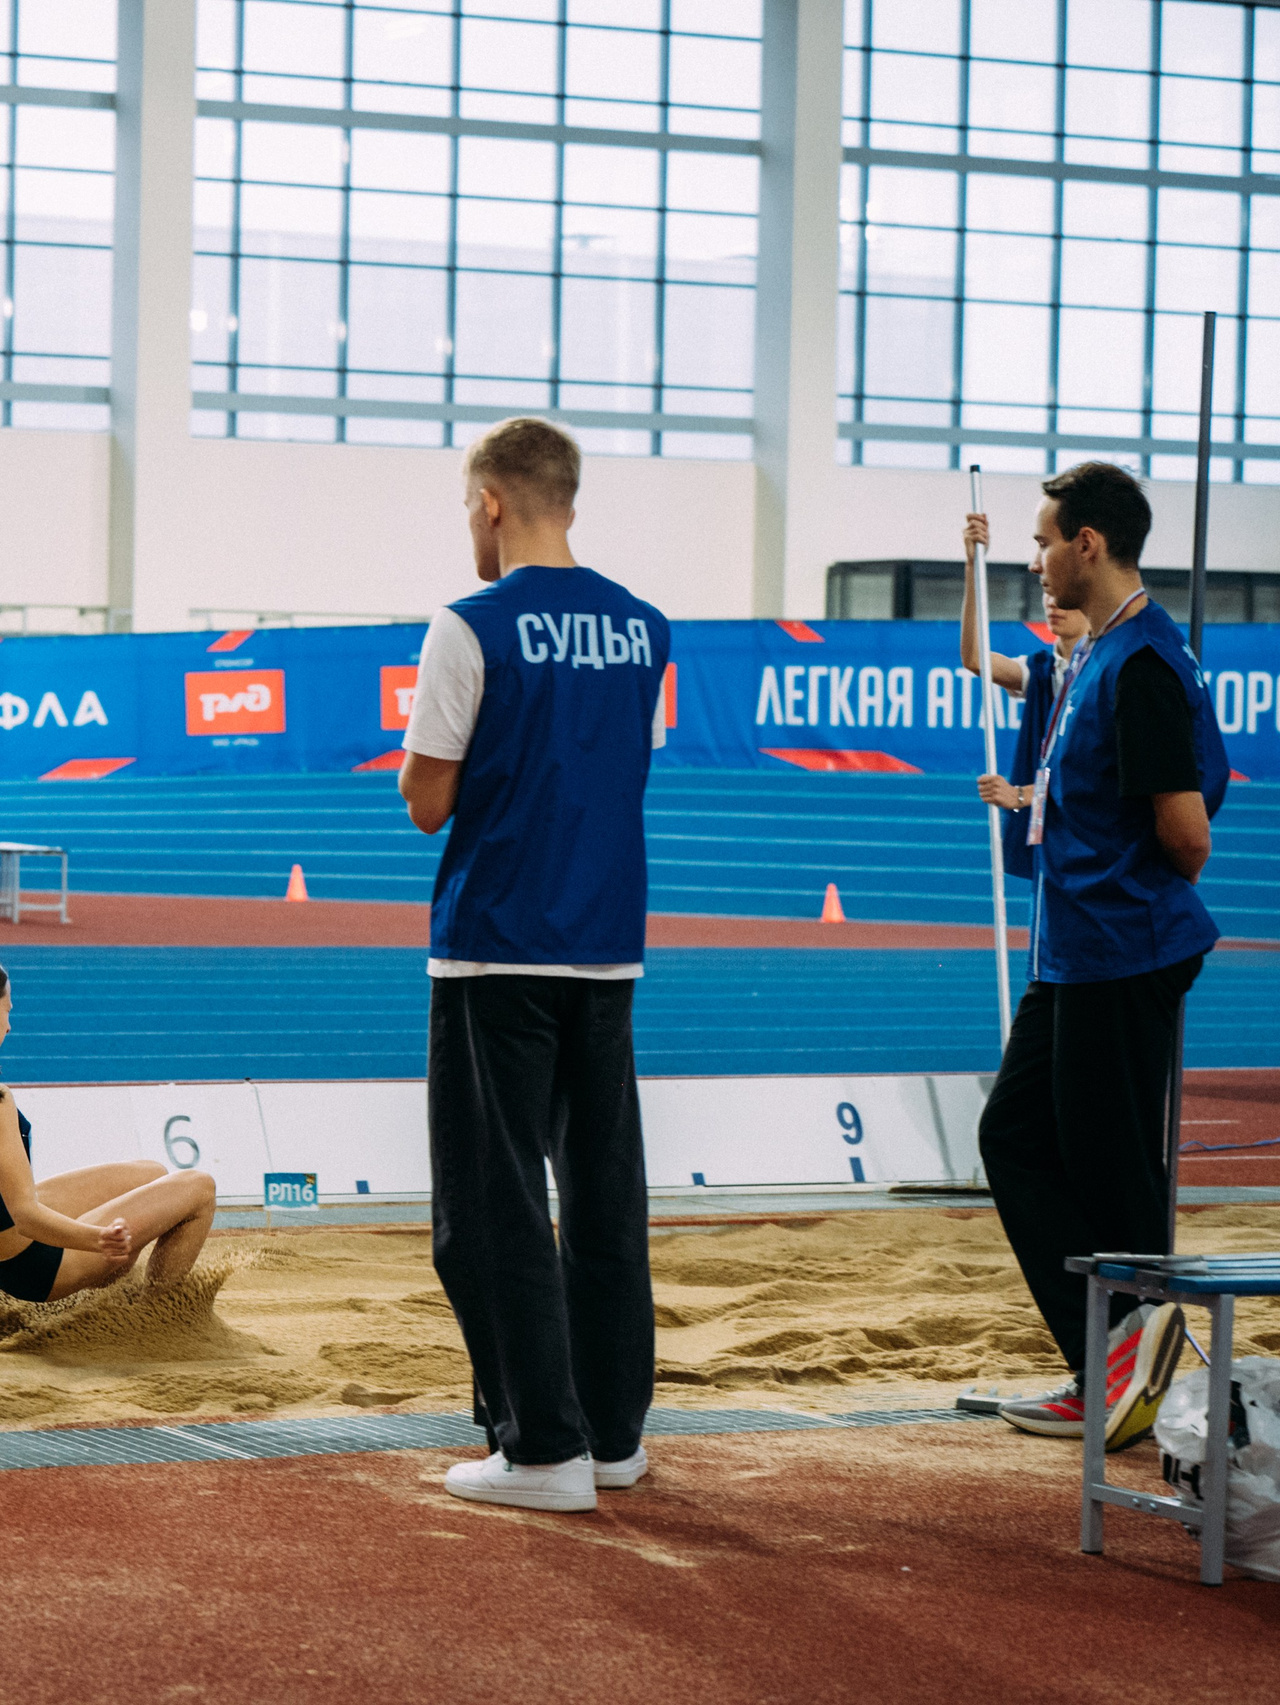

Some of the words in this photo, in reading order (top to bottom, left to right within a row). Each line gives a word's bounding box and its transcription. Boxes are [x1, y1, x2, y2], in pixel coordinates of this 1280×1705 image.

[516, 612, 653, 670] СУДЬЯ
[755, 665, 914, 728] ЛЕГКАЯ
[926, 667, 1023, 730] АТЛЕ
[164, 1115, 200, 1170] 6
[836, 1101, 863, 1145] 9
[268, 1182, 315, 1202] РЛ16
